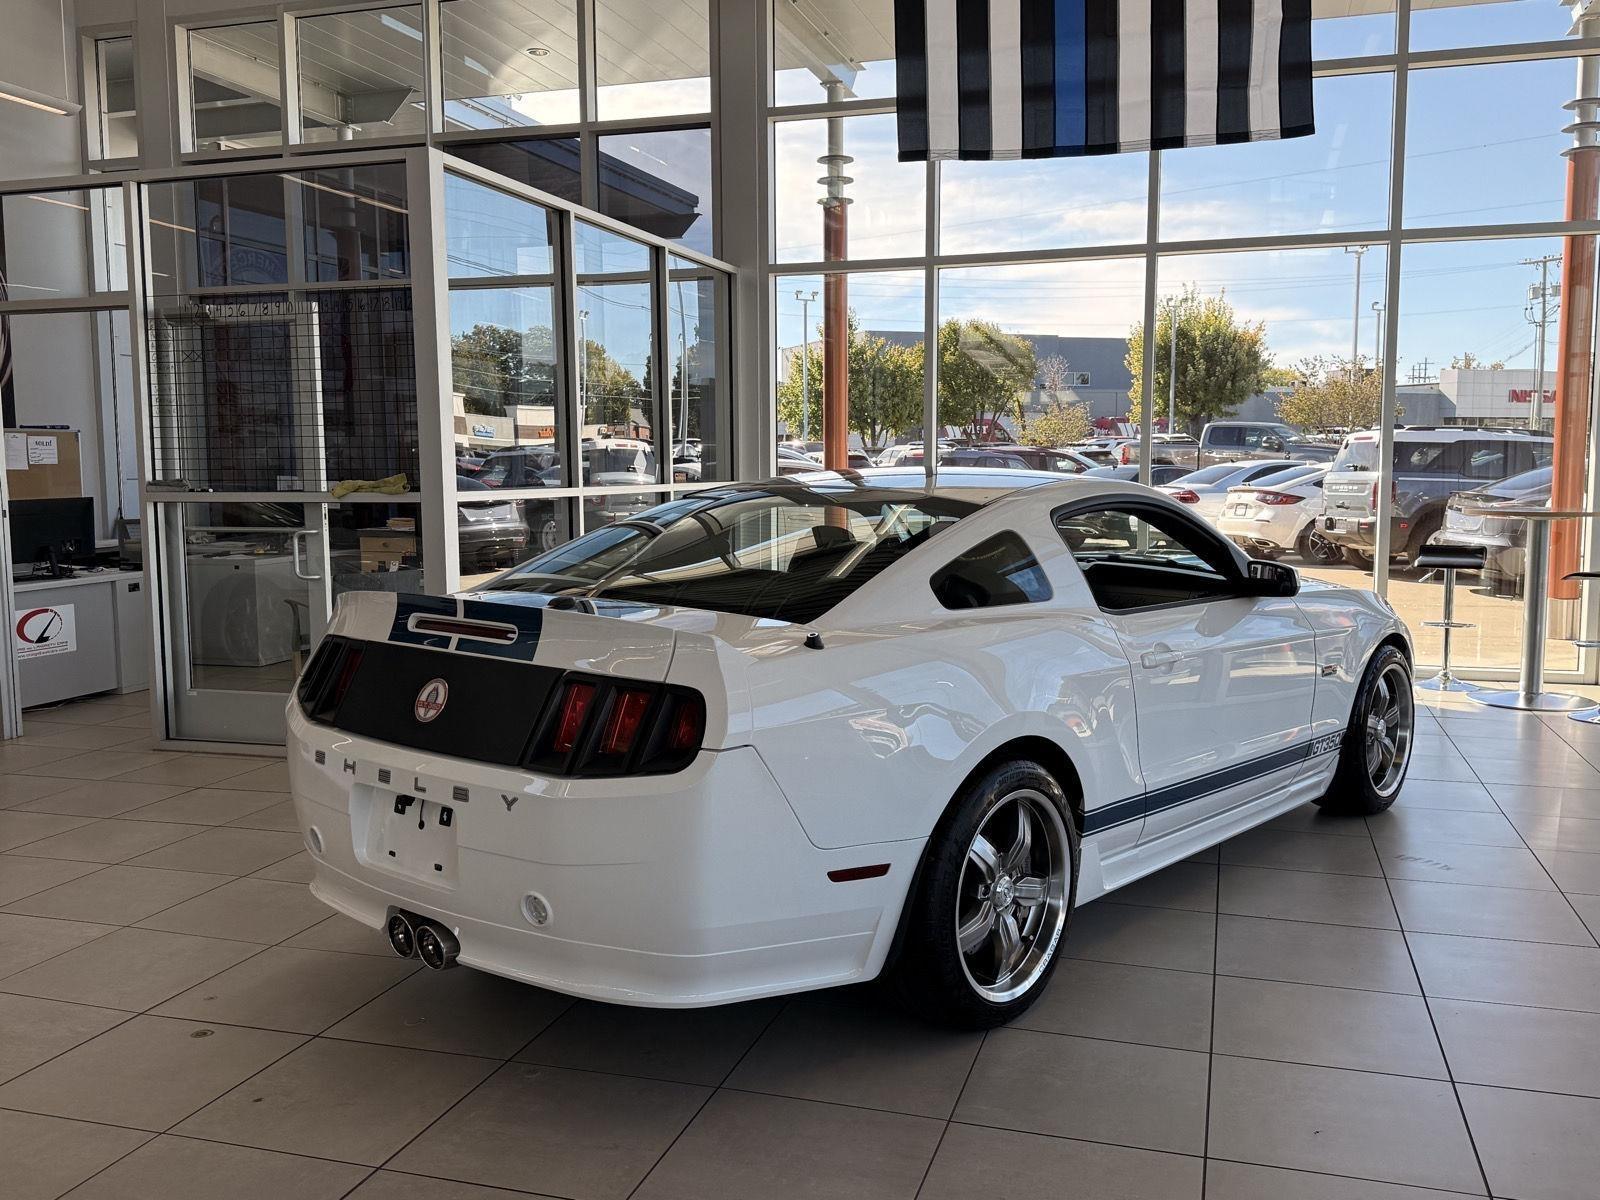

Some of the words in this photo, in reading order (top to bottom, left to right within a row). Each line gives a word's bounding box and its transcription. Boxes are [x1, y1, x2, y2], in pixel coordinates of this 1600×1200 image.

[237, 302, 246, 317] 6
[262, 301, 269, 316] 8
[274, 300, 281, 316] 9
[315, 750, 519, 811] SHELBY
